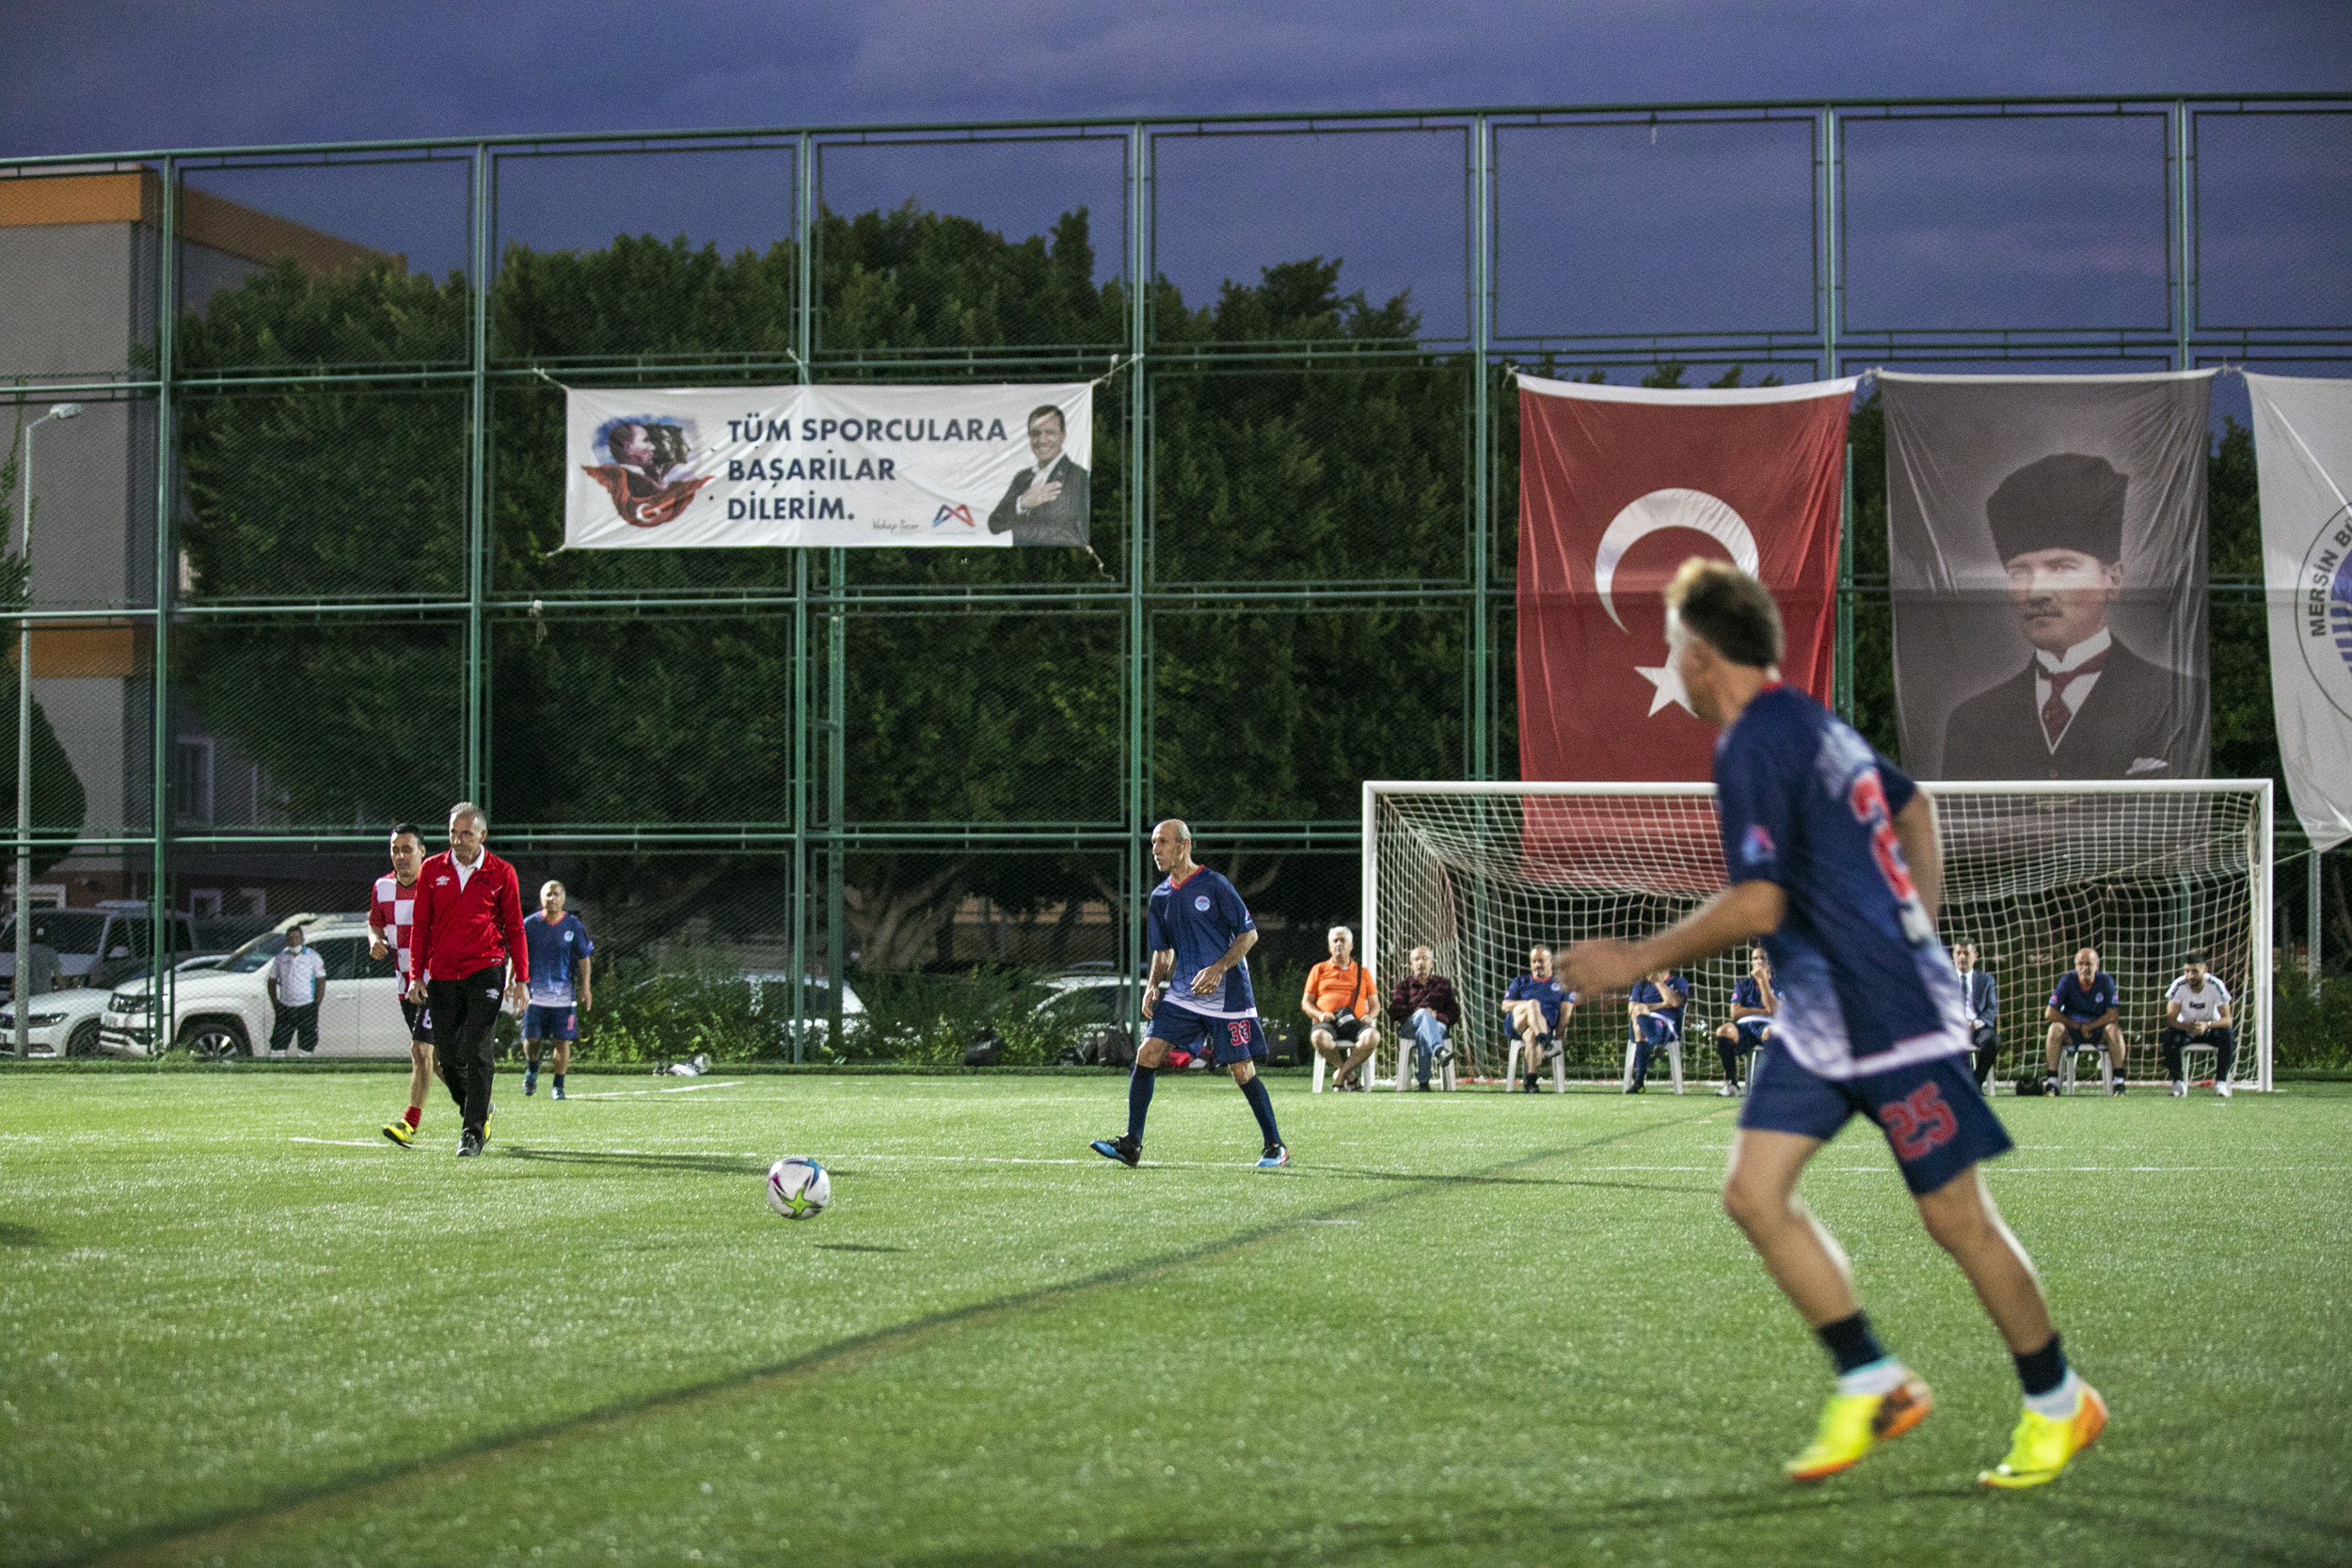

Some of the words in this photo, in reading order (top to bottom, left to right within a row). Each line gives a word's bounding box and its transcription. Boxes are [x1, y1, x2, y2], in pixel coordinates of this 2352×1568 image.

[727, 412, 792, 442] TÜM
[802, 418, 1008, 442] SPORCULARA
[727, 489, 855, 520] DİLERİM.
[2308, 548, 2340, 638] MERSİN
[1228, 1020, 1251, 1046] 33
[1879, 1081, 1959, 1160] 25
